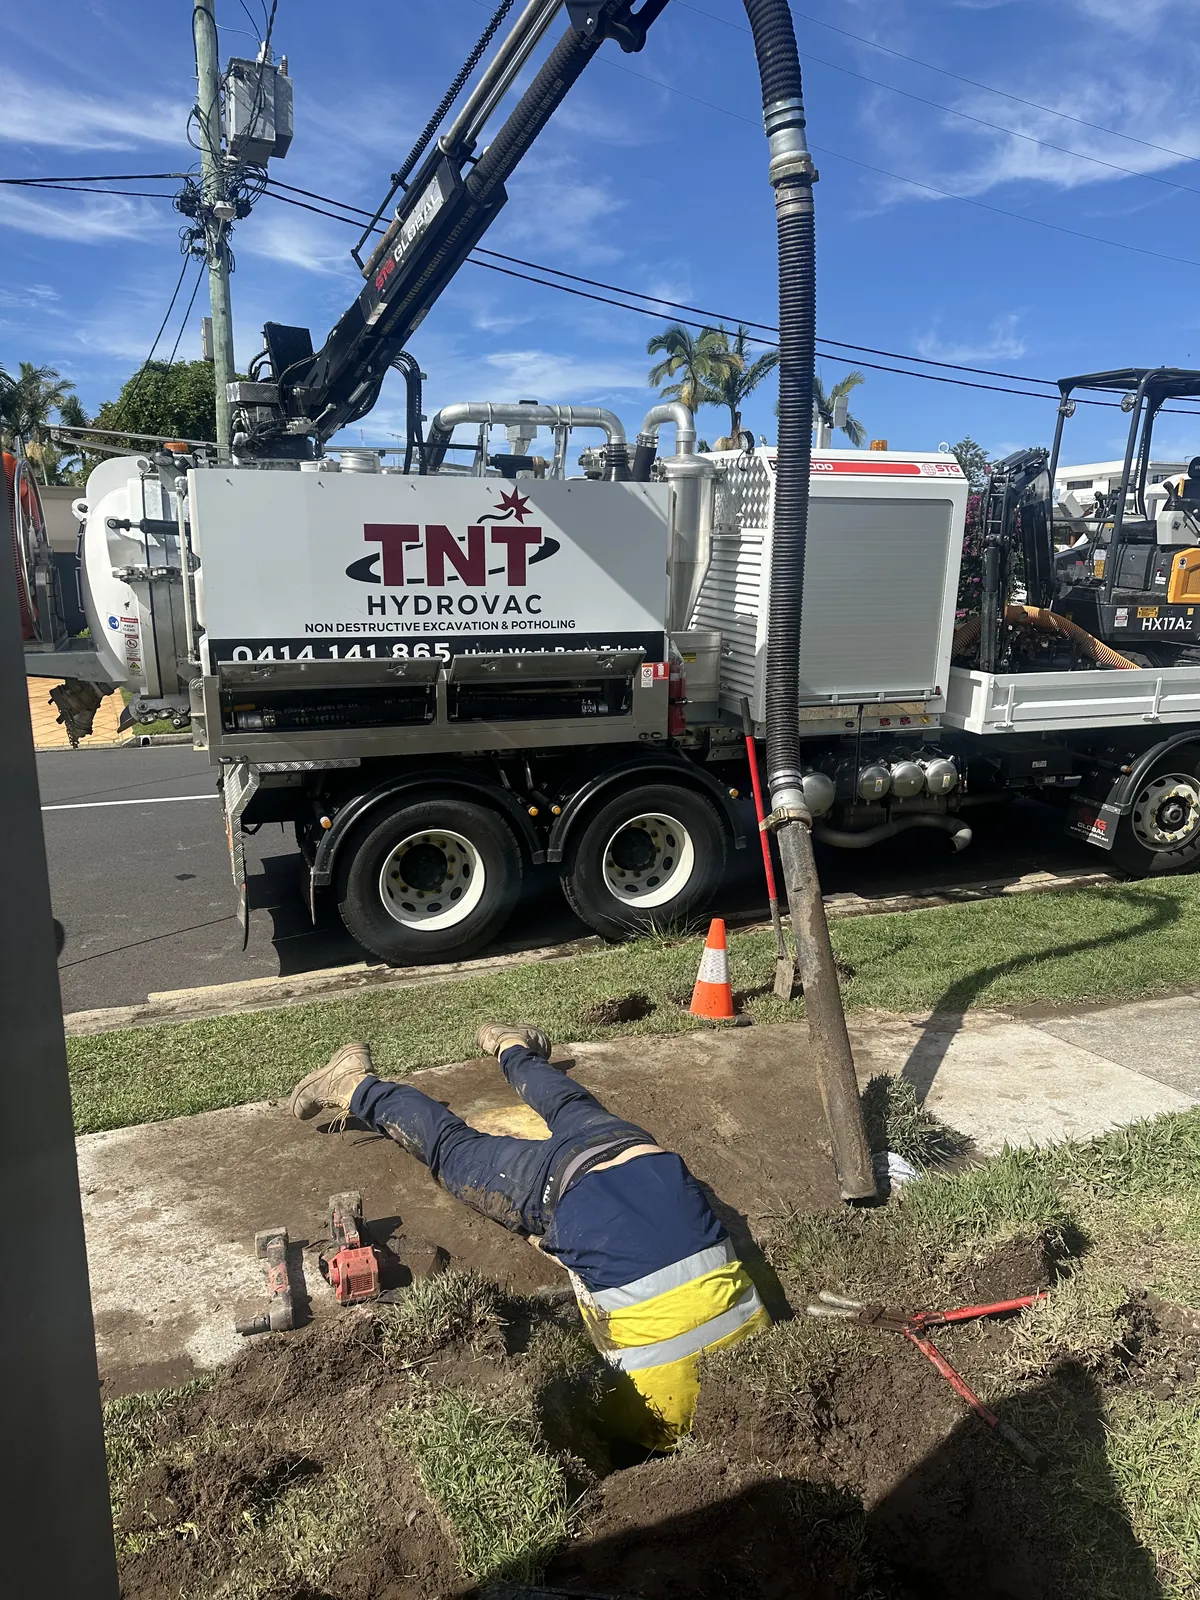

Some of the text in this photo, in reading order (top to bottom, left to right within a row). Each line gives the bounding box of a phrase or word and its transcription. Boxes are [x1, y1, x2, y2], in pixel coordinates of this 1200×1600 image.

[394, 194, 440, 262] GLOBAL
[935, 465, 960, 473] STG
[364, 523, 542, 586] TNT
[367, 594, 542, 615] HYDROVAC
[305, 619, 576, 633] NON DESTRUCTIVE EXCAVATION & POTHOLING
[232, 645, 315, 661] 0414
[329, 644, 377, 660] 141
[392, 642, 450, 662] 865
[1077, 822, 1105, 836] GLOBAL
